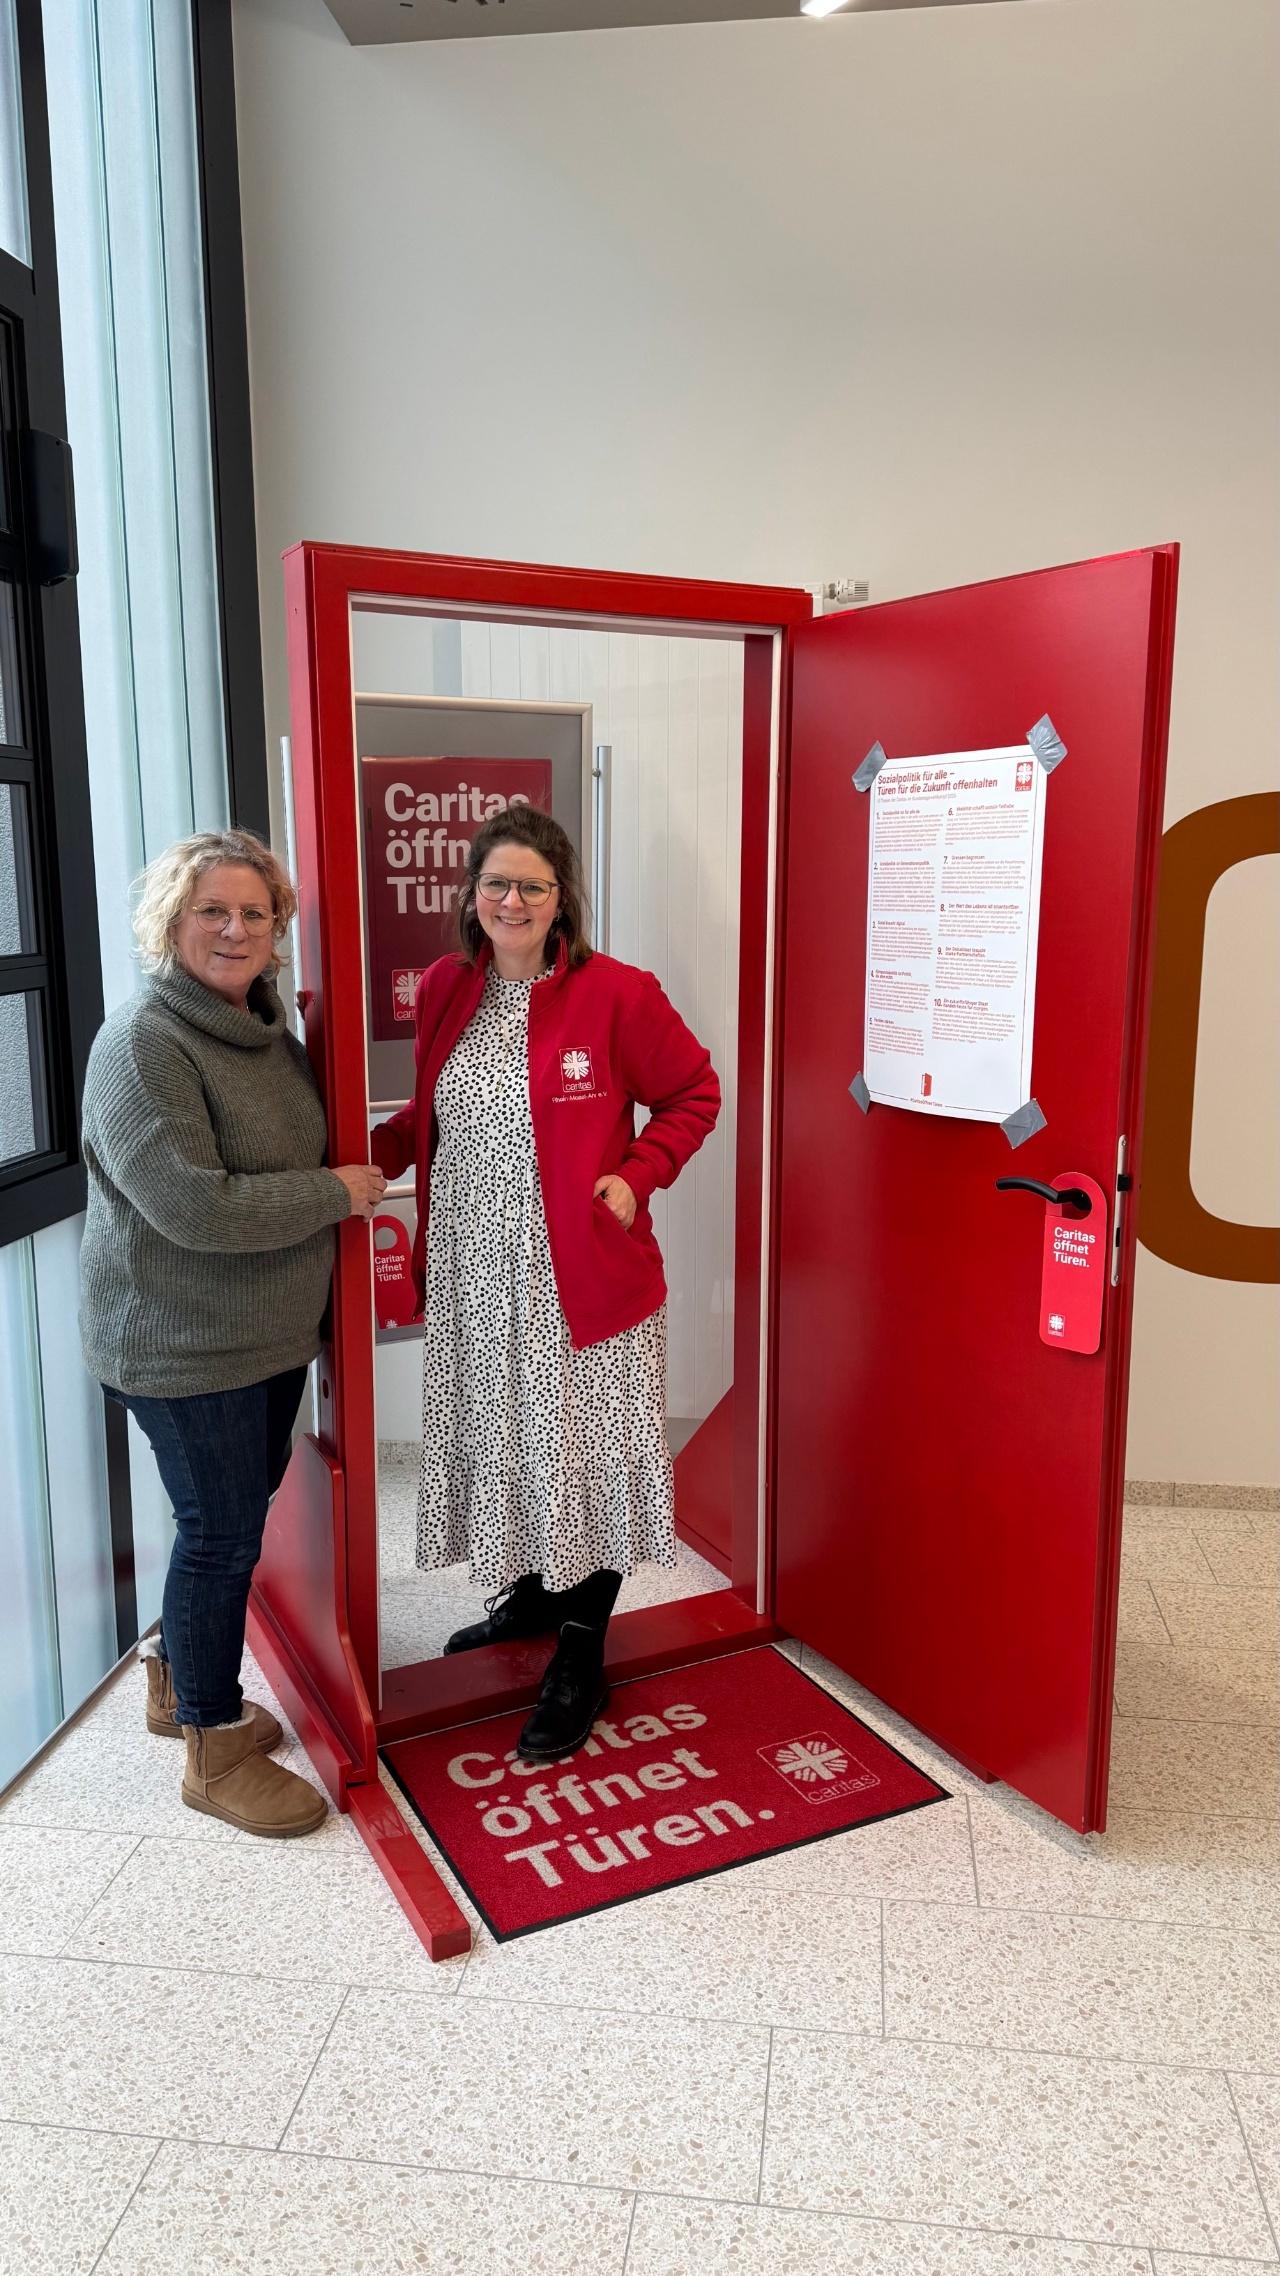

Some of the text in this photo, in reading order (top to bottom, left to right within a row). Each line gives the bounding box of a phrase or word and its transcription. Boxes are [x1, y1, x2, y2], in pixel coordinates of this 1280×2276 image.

[878, 771, 920, 784] Sozialpolitik
[923, 771, 933, 781] für
[935, 769, 947, 780] alle
[877, 778, 998, 795] Türen für die Zukunft offenhalten
[385, 828, 472, 869] öffn
[386, 875, 468, 914] Tür
[565, 1081, 592, 1091] caritas
[1054, 1226, 1096, 1244] Caritas
[1053, 1238, 1089, 1255] öffnet
[374, 1254, 405, 1265] Caritas
[1053, 1251, 1090, 1268] Türen.
[376, 1263, 402, 1274] öffnet
[377, 1271, 405, 1282] Türen.
[475, 1748, 718, 1837] öffnet
[807, 1774, 876, 1802] caritas
[504, 1799, 776, 1889] Türen.
